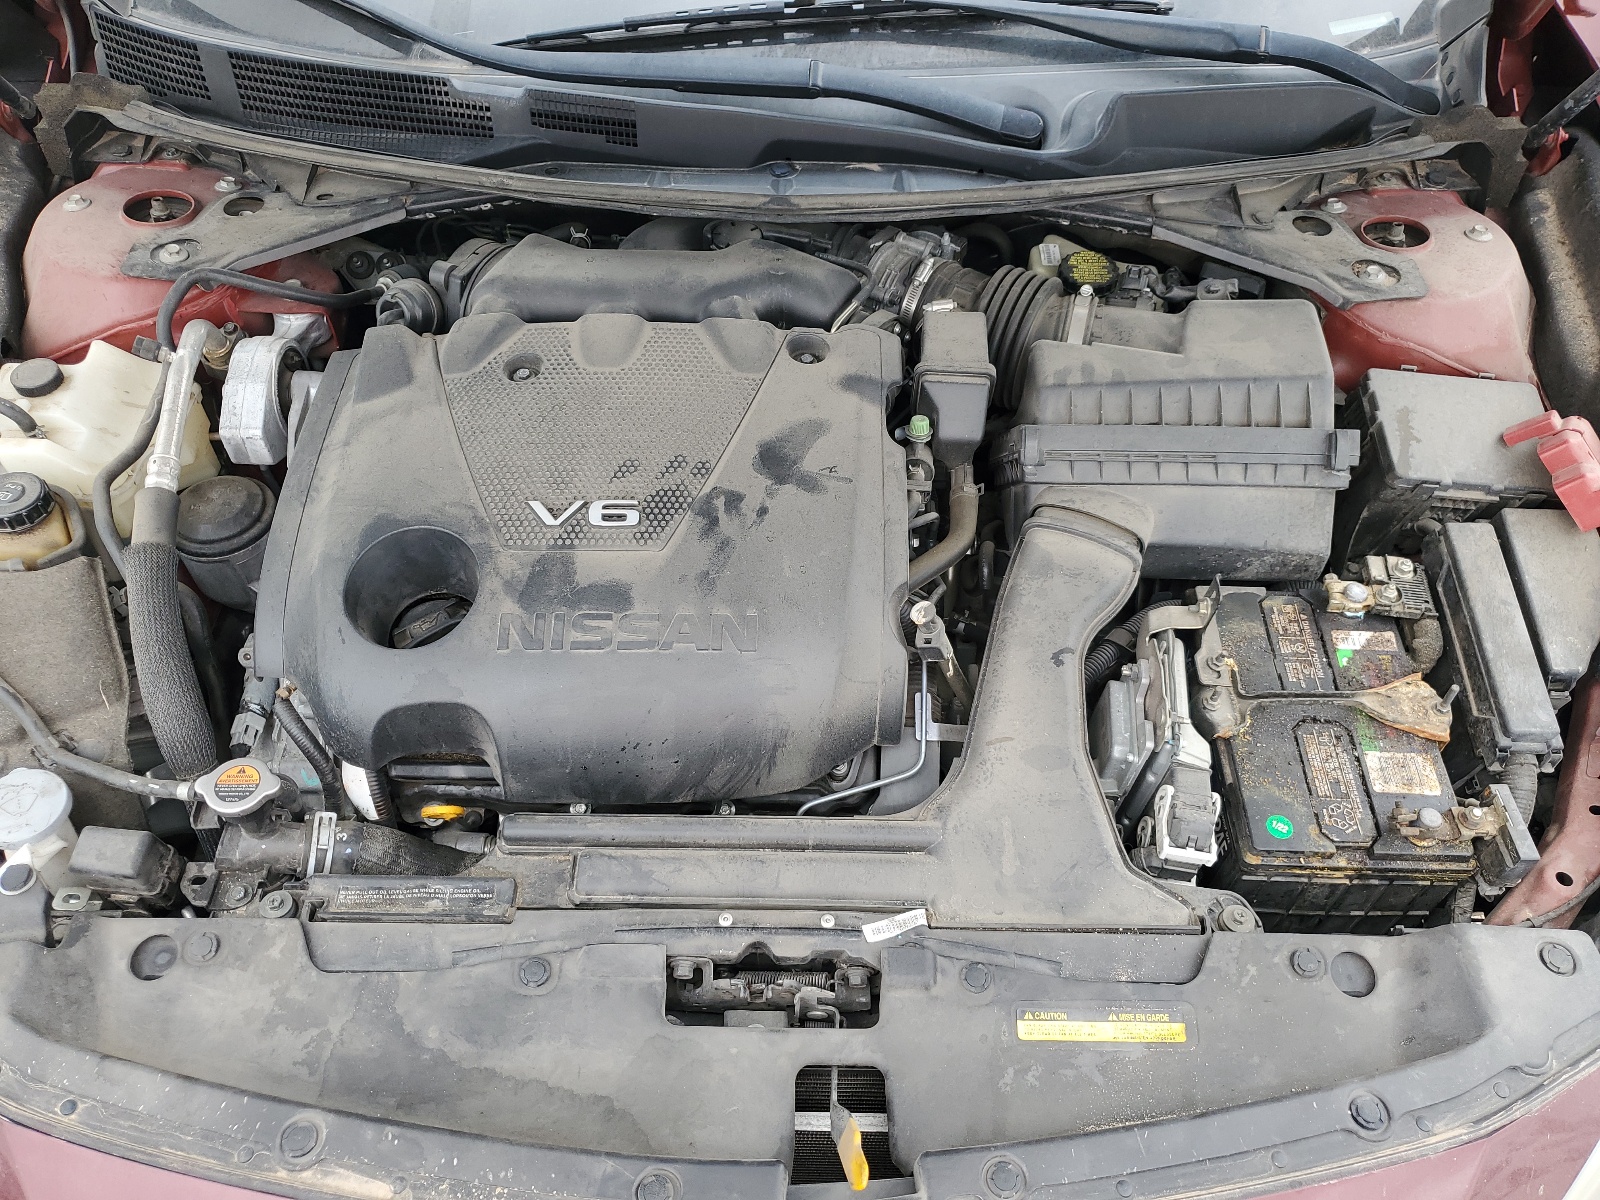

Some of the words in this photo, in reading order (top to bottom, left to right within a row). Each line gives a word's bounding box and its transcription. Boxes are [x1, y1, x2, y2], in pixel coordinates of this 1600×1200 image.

[525, 500, 641, 527] V6
[497, 612, 759, 653] NISSAN
[1302, 620, 1315, 647] DANGER
[1312, 653, 1325, 678] POISON
[1271, 820, 1289, 834] 1/22
[1034, 1011, 1067, 1020] CAUTION
[1119, 1013, 1135, 1021] MISE
[1136, 1013, 1145, 1021] EN
[1146, 1013, 1170, 1022] GARDE
